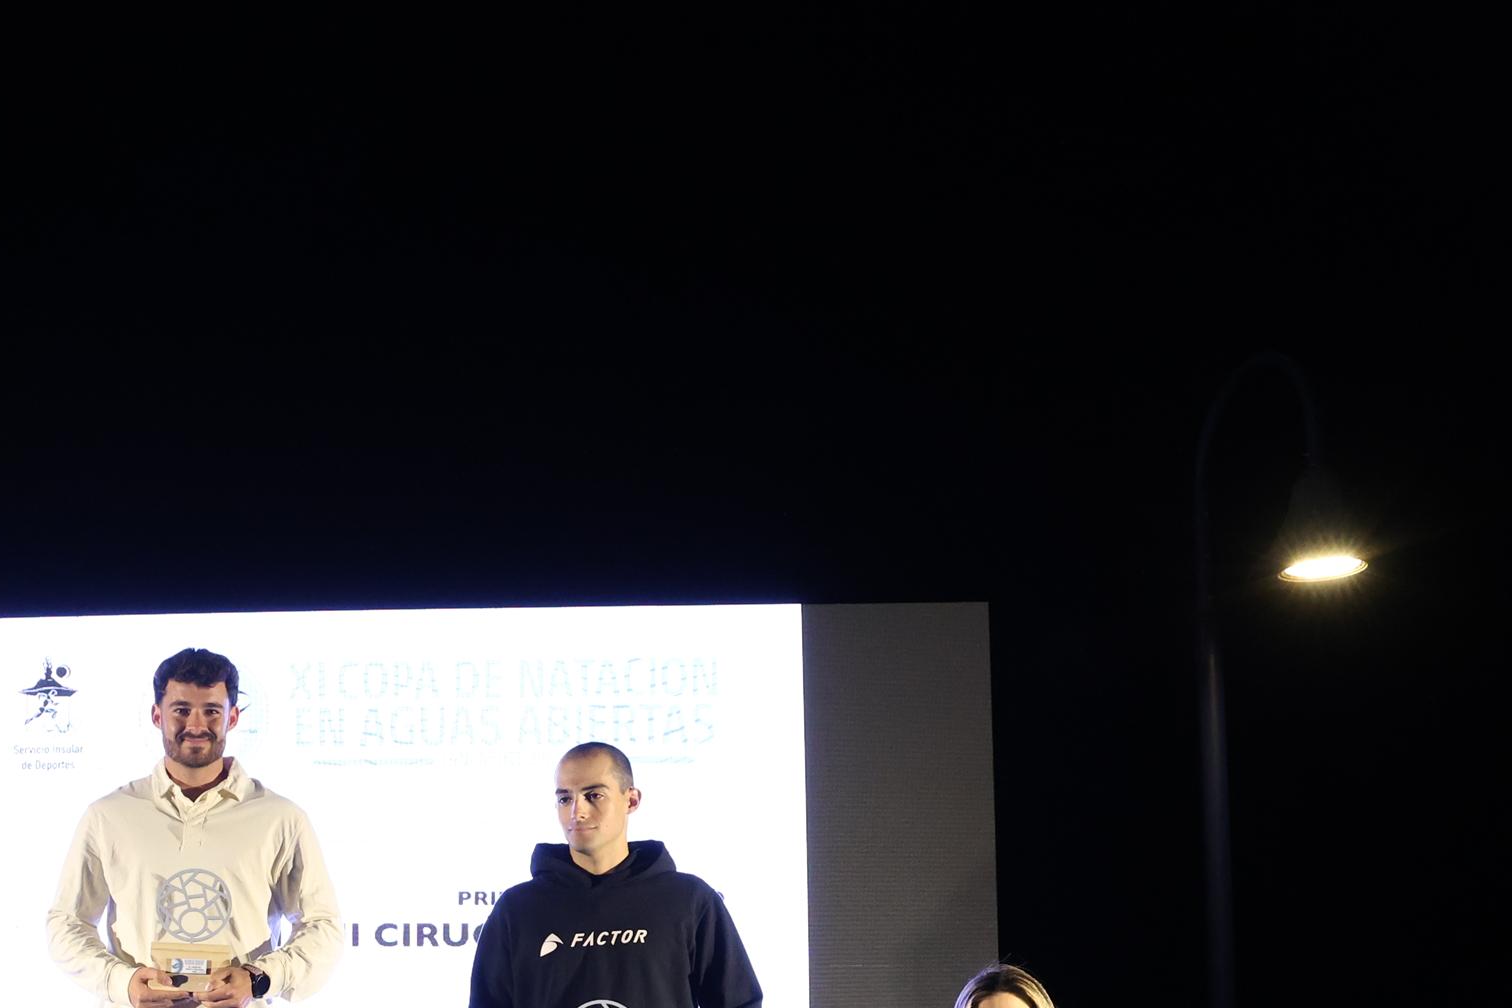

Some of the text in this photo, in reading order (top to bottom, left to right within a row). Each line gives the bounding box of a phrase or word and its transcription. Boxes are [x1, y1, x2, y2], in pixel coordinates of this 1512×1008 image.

[338, 659, 440, 700] COPA
[455, 657, 505, 699] DE
[520, 655, 719, 698] NATACION
[296, 703, 718, 747] EN AGUAS ABIERTAS
[570, 929, 648, 948] FACTOR
